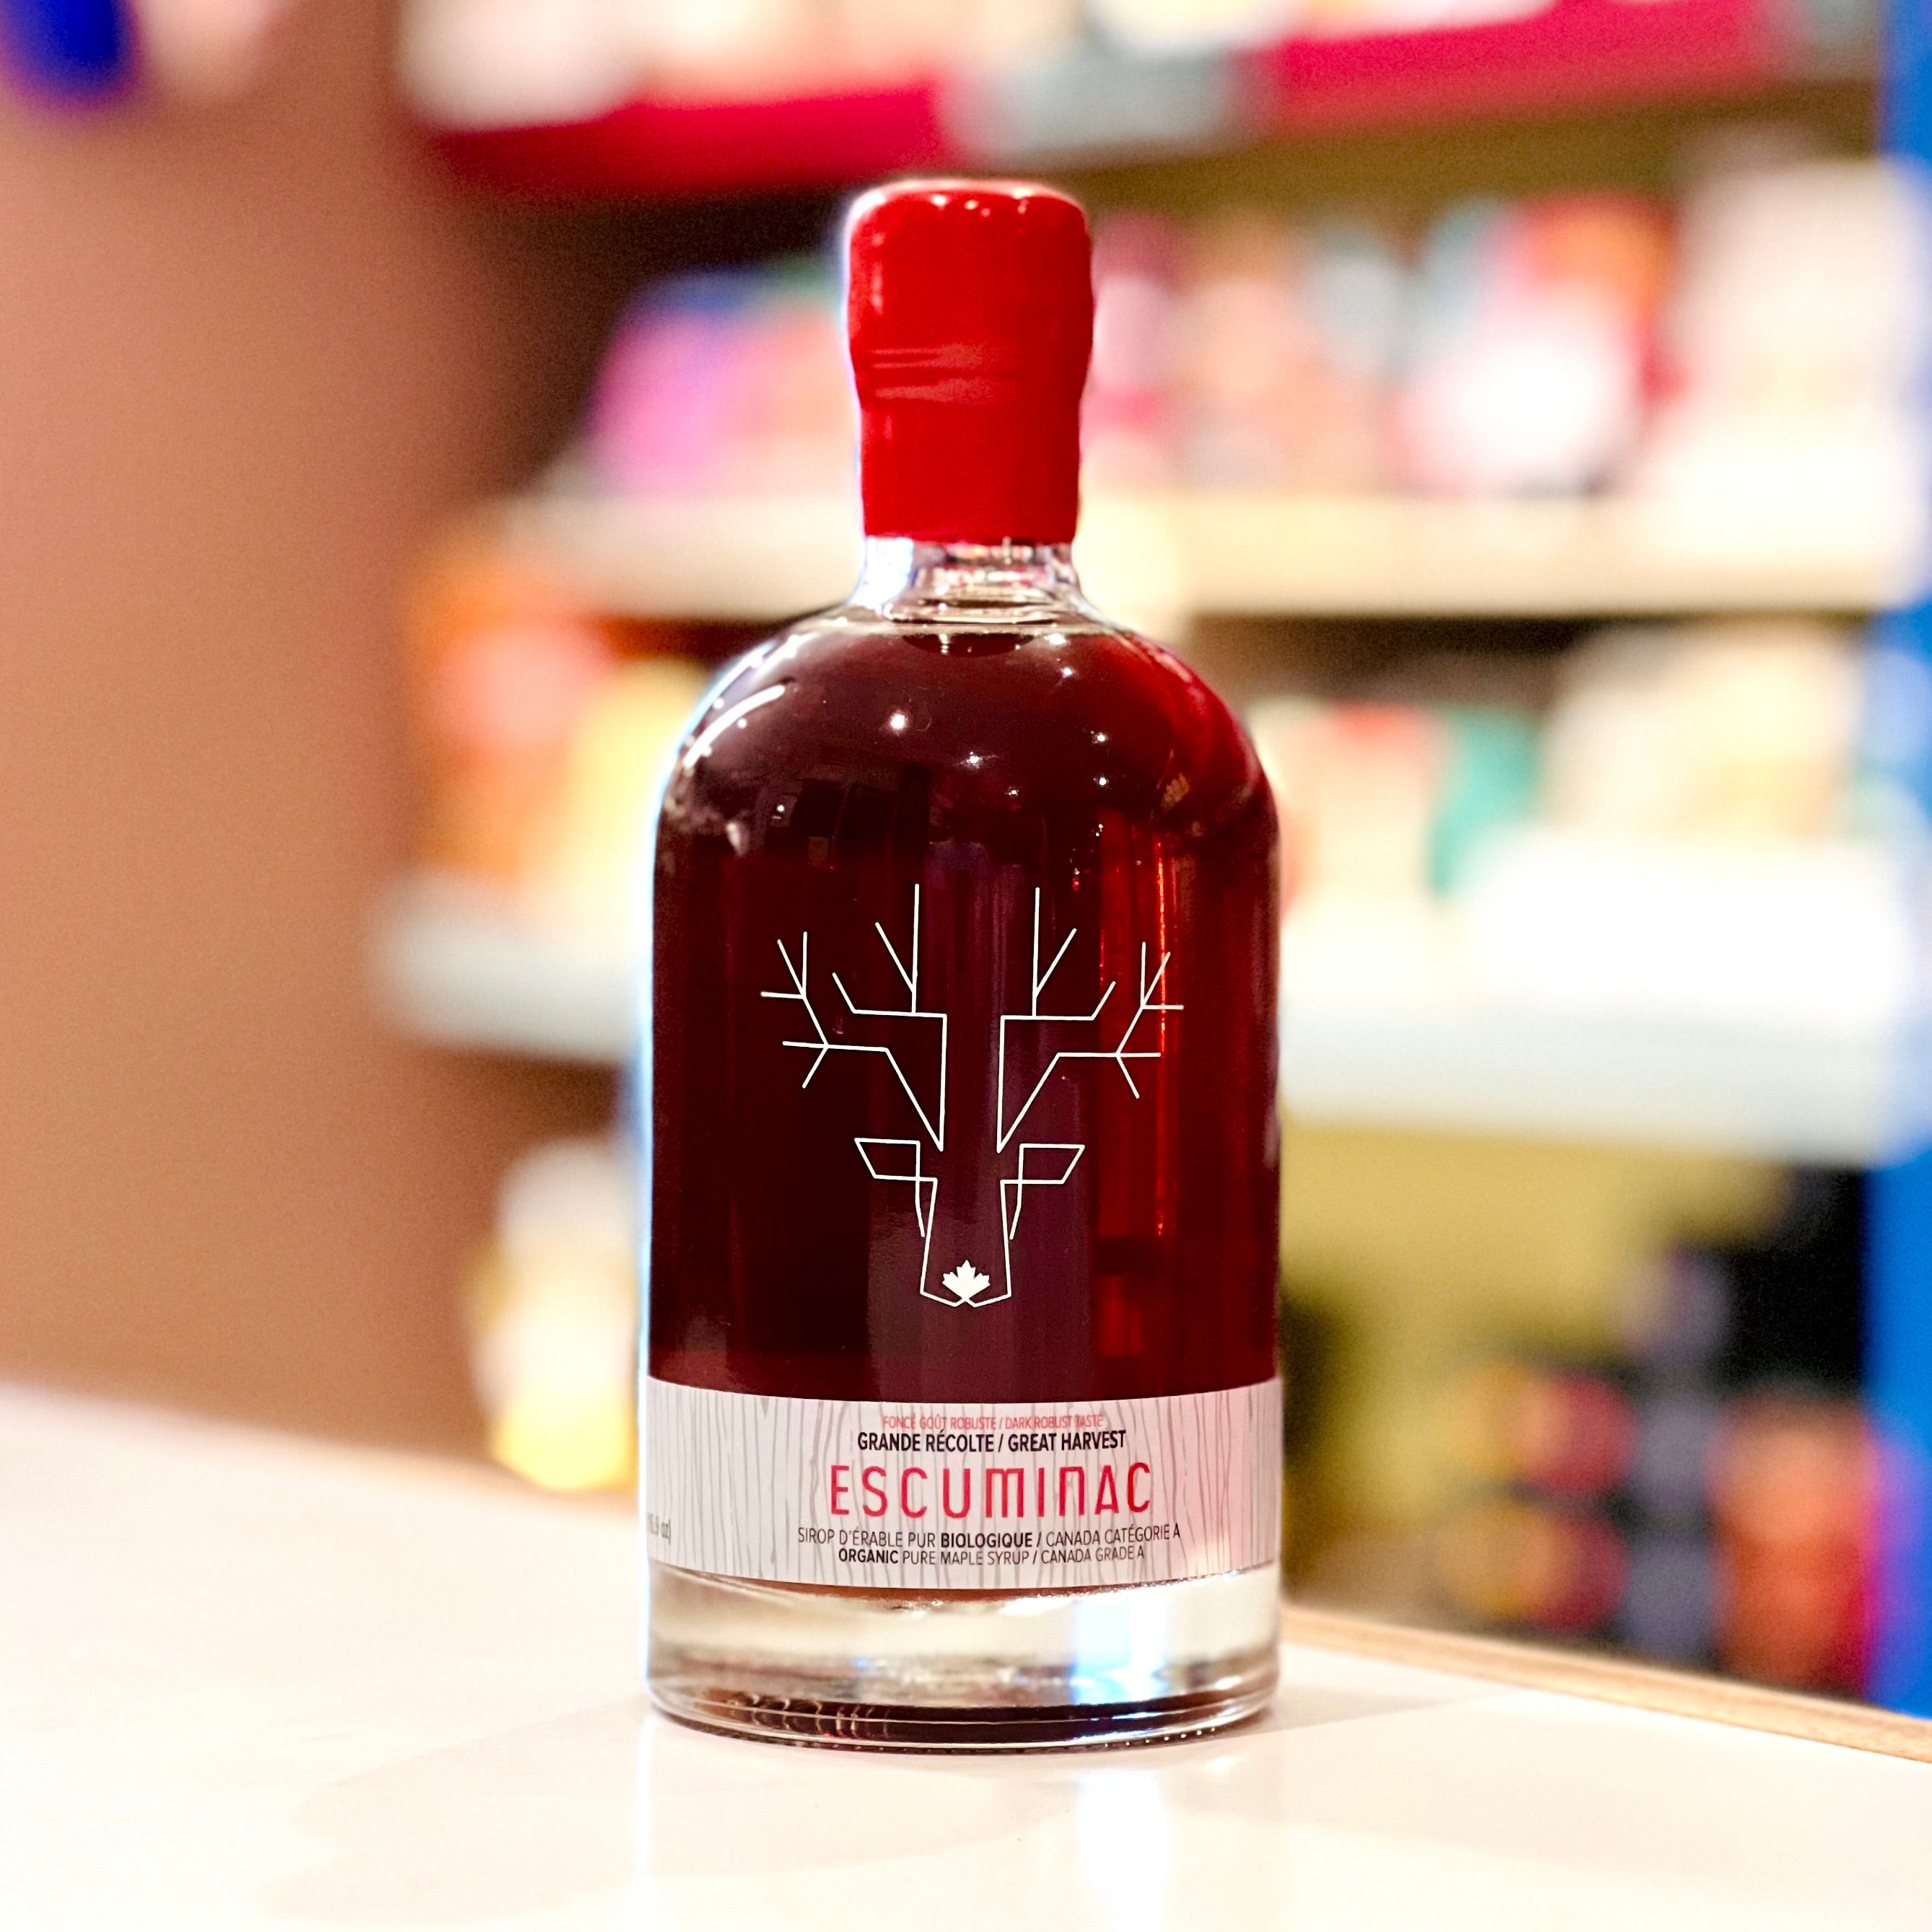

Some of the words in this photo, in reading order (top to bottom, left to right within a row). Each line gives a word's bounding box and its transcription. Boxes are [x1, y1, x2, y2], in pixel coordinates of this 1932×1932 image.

[882, 1413, 915, 1429] FONCÉ
[919, 1414, 947, 1429] GOÛT
[950, 1416, 996, 1430] ROBUSTE
[1005, 1416, 1032, 1429] DARK
[1034, 1415, 1073, 1428] ROBUST
[1075, 1414, 1103, 1428] TASTE
[858, 1432, 921, 1452] GRANDE
[926, 1429, 994, 1452] RÉCOLTE
[998, 1433, 1004, 1452] /
[1008, 1433, 1057, 1452] GREAT
[1061, 1430, 1126, 1451] HARVEST
[831, 1462, 1151, 1519] ESCUMINAC
[798, 1527, 835, 1544] SIROP
[839, 1527, 903, 1547] D'ÉRABLE
[908, 1532, 935, 1547] PUR
[941, 1532, 1032, 1547] BIOLOGIQUE
[1036, 1532, 1042, 1547] /
[1046, 1530, 1100, 1547] CANADA
[1105, 1524, 1169, 1545] CATÉGORIE
[1173, 1523, 1180, 1538] A
[838, 1548, 898, 1564] ORGANIC
[903, 1550, 936, 1565] PURE
[941, 1551, 983, 1565] MAPLE
[987, 1551, 1029, 1565] SYRUP
[1032, 1550, 1037, 1565] /
[1041, 1549, 1091, 1563] CANADA
[1096, 1546, 1134, 1562] GRADE
[1137, 1546, 1144, 1559] A
